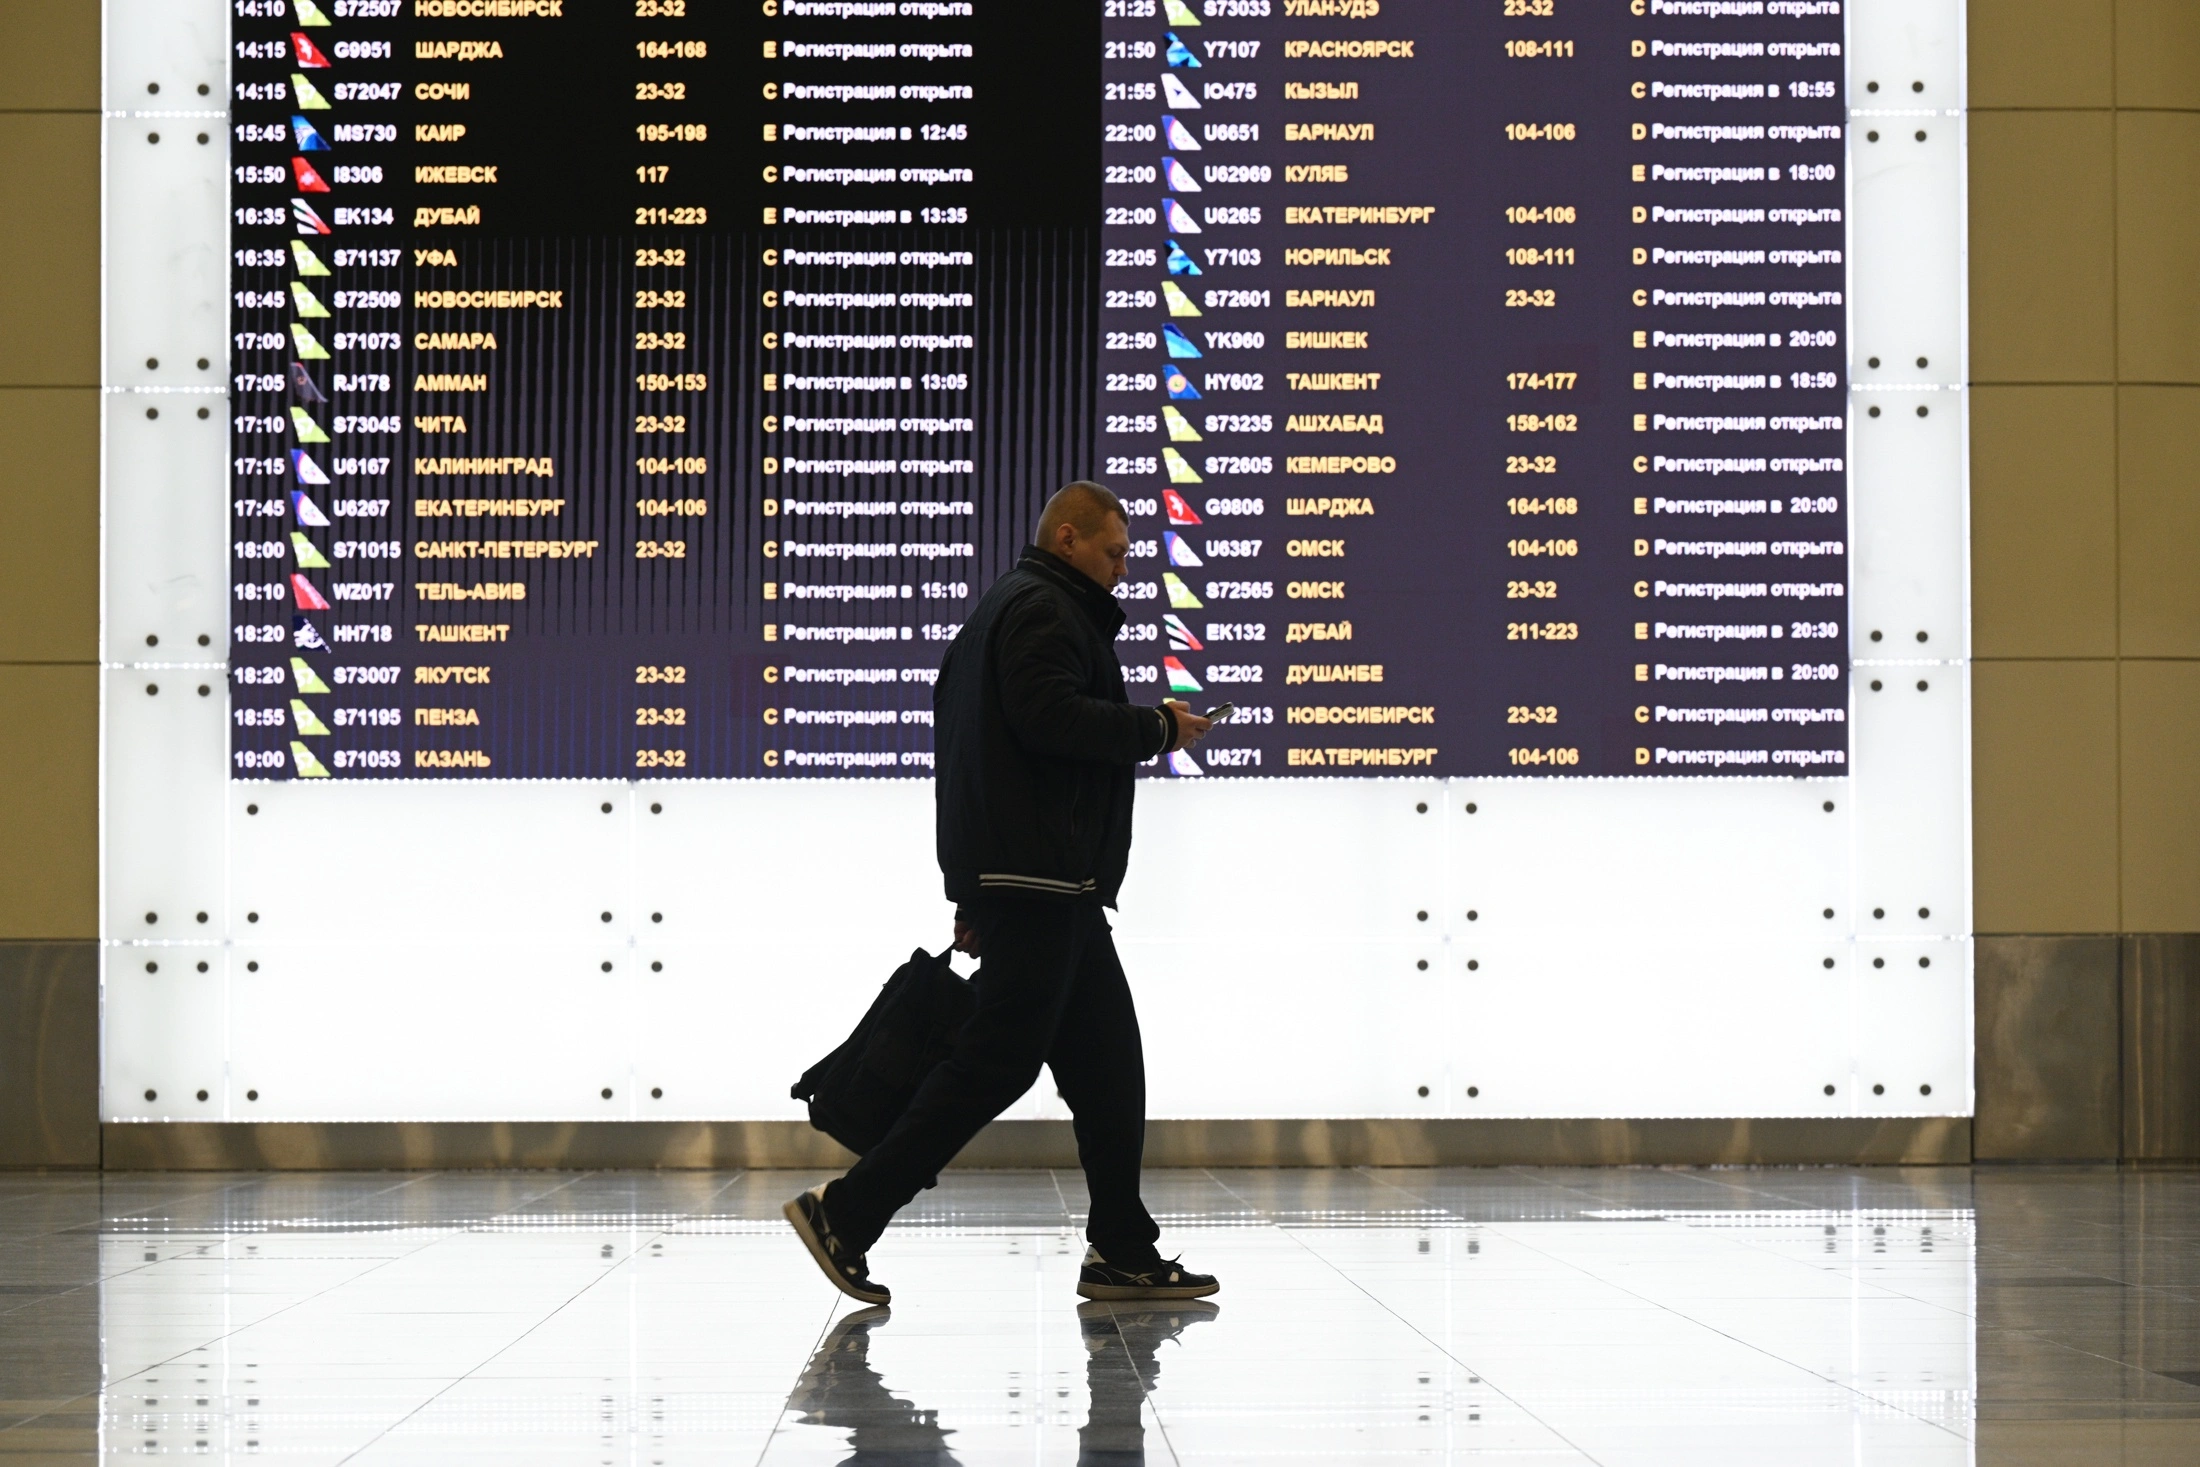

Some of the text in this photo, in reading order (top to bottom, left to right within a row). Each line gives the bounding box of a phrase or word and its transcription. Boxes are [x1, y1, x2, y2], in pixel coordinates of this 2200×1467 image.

[235, 0, 285, 16] 14:10
[334, 0, 401, 16] S72507
[415, 0, 562, 16] НОВОСИБИРСК
[636, 0, 685, 16] 23-32
[763, 0, 777, 16] C
[783, 0, 895, 19] Регистрация
[900, 3, 972, 19] открыта
[1105, 40, 1840, 60] 21:50 Y7107 КРАСНОЯРСК 108-111 D Регистрация открыта
[1105, 81, 1835, 101] 21:55 IO475 КЫЗЫЛ C Регистрация в 18:55
[236, 124, 967, 144] 15:45 MS730 КАИР 195-198 E Регистрация в 12:45
[1105, 164, 1835, 184] 22:00 U62969 КУЛЯБ E Регистрация в 18:00
[235, 206, 967, 227] 16:35 EK134 ДУБАЙ 211-223 E Регистрация в 13:35
[1105, 206, 1841, 226] 22:00 U6265 ЕКАТЕРИНБУРГ 104-106 D Регистрация открыта
[235, 291, 285, 308] 16:45
[334, 291, 401, 308] S72509
[415, 291, 562, 308] НОВОСИБИРСК
[636, 291, 685, 307] 23-32
[763, 291, 777, 307] C
[784, 290, 896, 310] Регистрация
[900, 293, 972, 310] открыта
[1106, 291, 1156, 307] 22:50
[1205, 290, 1270, 307] S72601
[1286, 290, 1375, 307] БАРНАУЛ
[1506, 290, 1555, 306] 23-32
[1633, 289, 1647, 306] C
[1653, 289, 1765, 309] Регистрация
[1769, 292, 1842, 309] открыта
[235, 374, 967, 393] 17:05 RJ178 АММАН 150-153 E Регистрация в 13:05
[1106, 372, 1837, 392] 22:50 HY602 ТАШКЕНТ 174-177 E Регистрация в 18:50
[235, 457, 973, 477] 17:15 U6167 КАЛИНИНГРАД 104-106 D Регистрация открыта
[1106, 457, 1157, 474] 22:55
[1205, 457, 1272, 474] S72605
[1287, 456, 1396, 473] КЕМЕРОВО
[1506, 456, 1556, 473] 23-32
[1633, 456, 1648, 473] C
[1654, 456, 1766, 475] Регистрация
[1770, 458, 1843, 475] открыта
[1119, 497, 1838, 518] 3:00 G9806 ШАРДЖА 164-168 E Регистрация в 20:00
[234, 541, 285, 558] 18:00
[333, 541, 401, 558] S71015
[415, 541, 598, 558] САНКТ-ПЕТЕРБУРГ
[636, 541, 685, 558] 23-32
[764, 541, 777, 558] C
[784, 541, 896, 560] Регистрация
[900, 543, 973, 560] открыта
[234, 582, 968, 602] 18:10 WZ017 ТЕЛЬ-АВИВ E Регистрация в 15:10
[234, 667, 284, 684] 18:20
[334, 667, 401, 684] S73007
[415, 667, 490, 683] ЯКУТСК
[636, 666, 685, 683] 23-32
[764, 666, 778, 683] C
[784, 666, 897, 686] Регистрация
[901, 669, 939, 686] откр
[1121, 664, 1839, 685] 3:30 SZ202 ДУШАНБЕ E Регистрация в 20:00
[234, 750, 285, 768] 19:00
[334, 750, 401, 768] S71053
[415, 750, 491, 767] КАЗАНЬ
[636, 750, 686, 767] 23-32
[764, 750, 778, 767] C
[784, 750, 897, 769] Регистрация
[1207, 748, 1845, 767] U6271 ЕКАТЕРИНБУРГ 104-106 D Регистрация открыта
